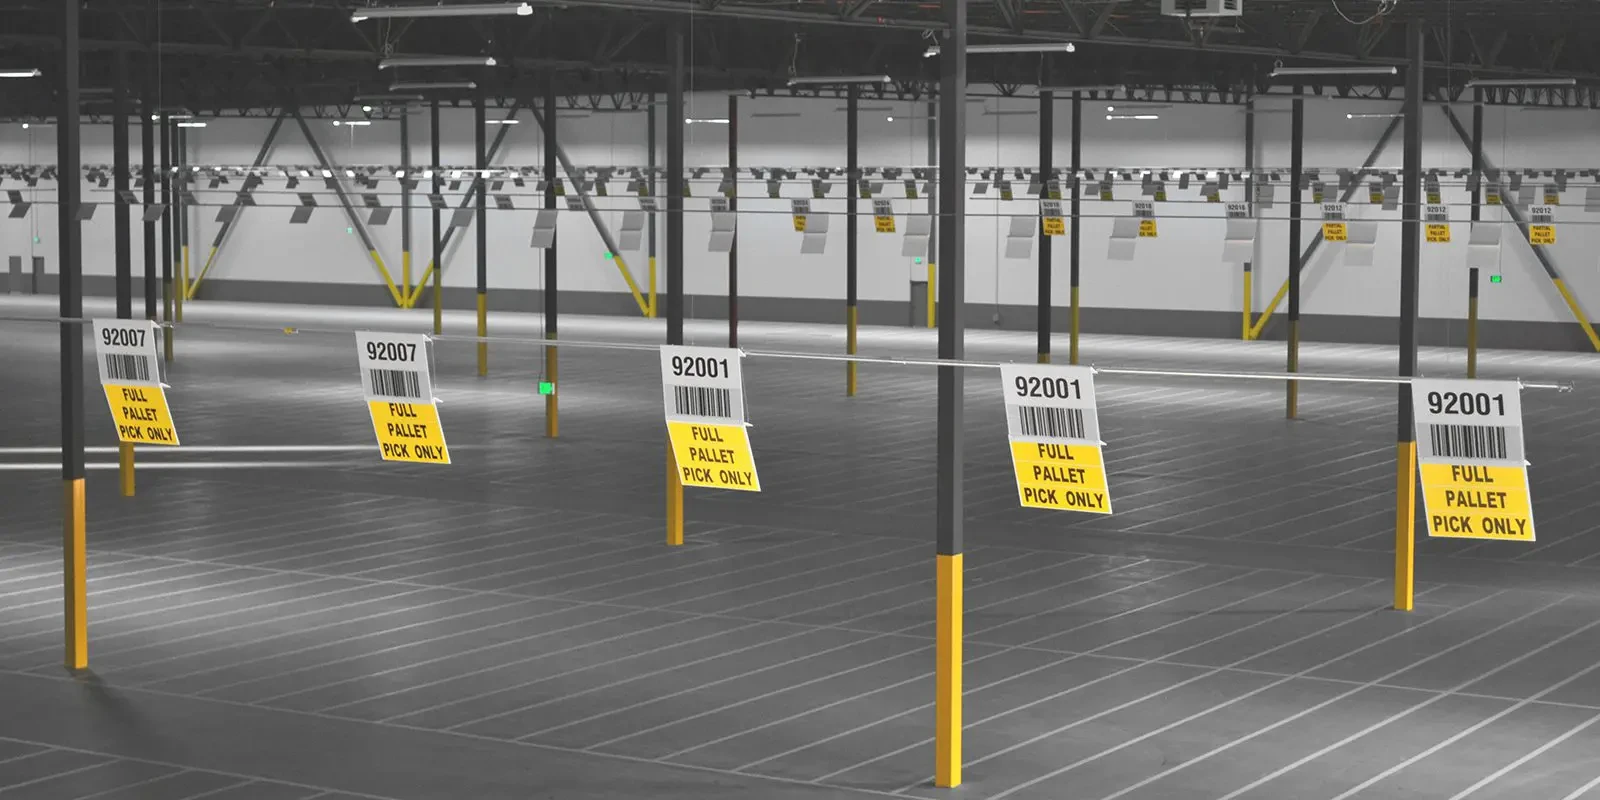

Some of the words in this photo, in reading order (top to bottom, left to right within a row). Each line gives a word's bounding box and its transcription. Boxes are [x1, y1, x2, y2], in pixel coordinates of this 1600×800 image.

[102, 328, 146, 347] 92007
[367, 341, 416, 361] 92007
[672, 356, 728, 378] 92001
[122, 388, 148, 402] FULL
[1015, 376, 1081, 399] 92001
[389, 403, 417, 417] FULL
[1427, 391, 1504, 416] 92001
[123, 406, 157, 421] PALLET
[120, 425, 143, 439] PICK
[147, 427, 173, 441] ONLY
[388, 423, 427, 438] PALLET
[692, 426, 724, 442] FULL
[383, 443, 410, 458] PICK
[415, 445, 443, 460] ONLY
[690, 447, 735, 464] PALLET
[1038, 443, 1074, 460] FULL
[683, 467, 714, 483] PICK
[720, 470, 752, 486] ONLY
[1033, 465, 1085, 484] PALLET
[1451, 465, 1494, 483] FULL
[1024, 487, 1058, 505] PICK
[1066, 491, 1103, 508] ONLY
[1445, 490, 1507, 509] PALLET
[1432, 515, 1472, 533] PICK
[1482, 517, 1526, 535] ONLY
